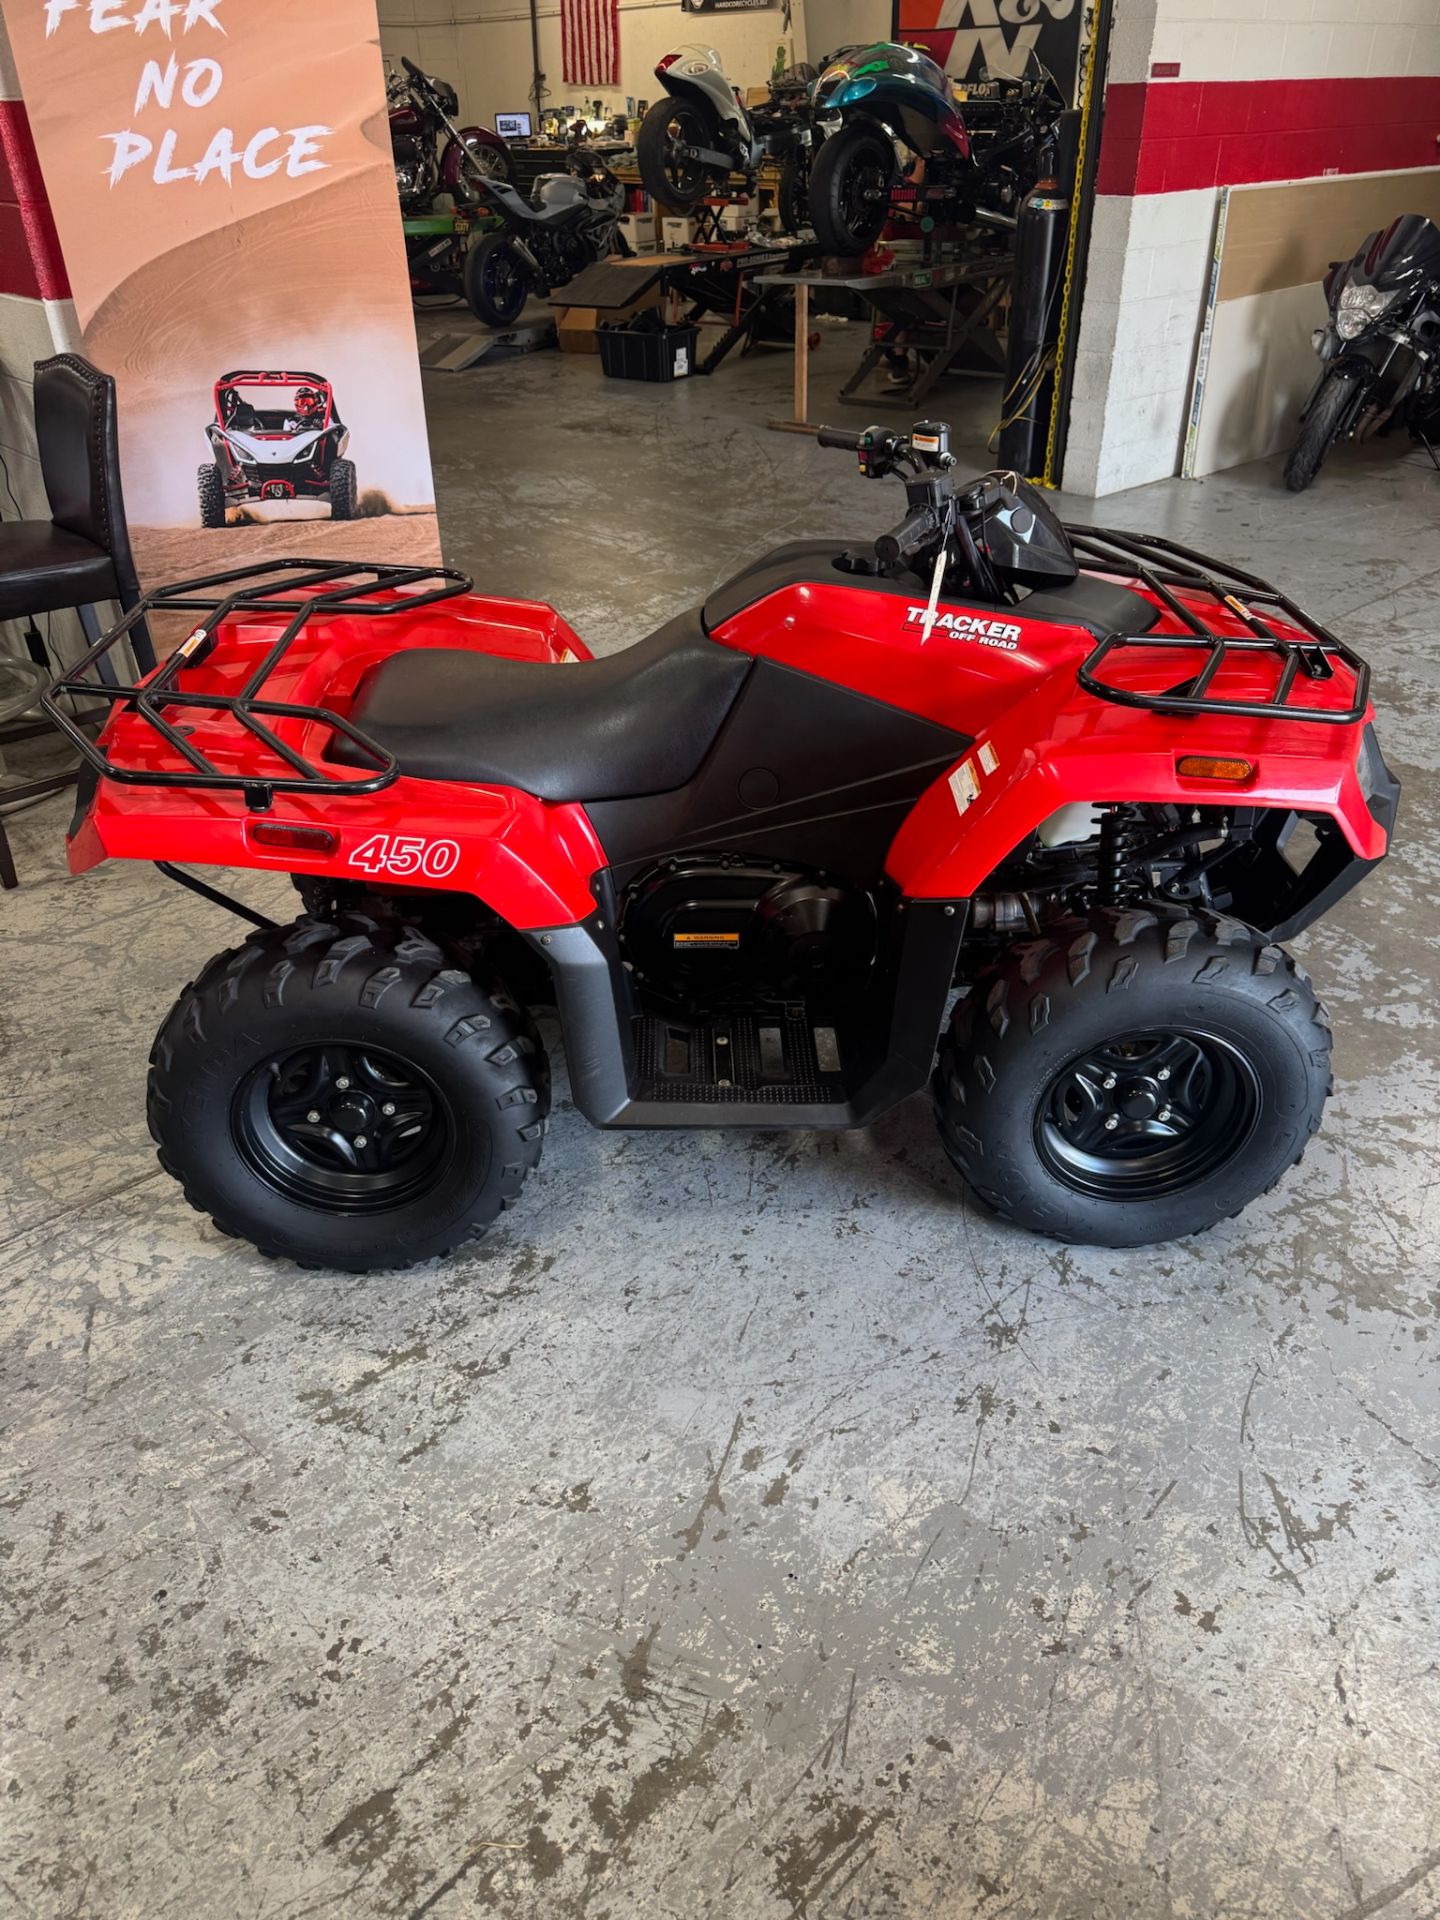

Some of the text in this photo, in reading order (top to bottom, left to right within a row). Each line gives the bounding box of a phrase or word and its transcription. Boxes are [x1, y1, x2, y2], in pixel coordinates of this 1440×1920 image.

[45, 0, 228, 40] FEAR
[134, 50, 223, 116] NO
[97, 124, 334, 190] PLACE
[906, 606, 1022, 641] TRACKER
[948, 630, 1018, 651] OFF ROAD
[348, 834, 460, 878] 450
